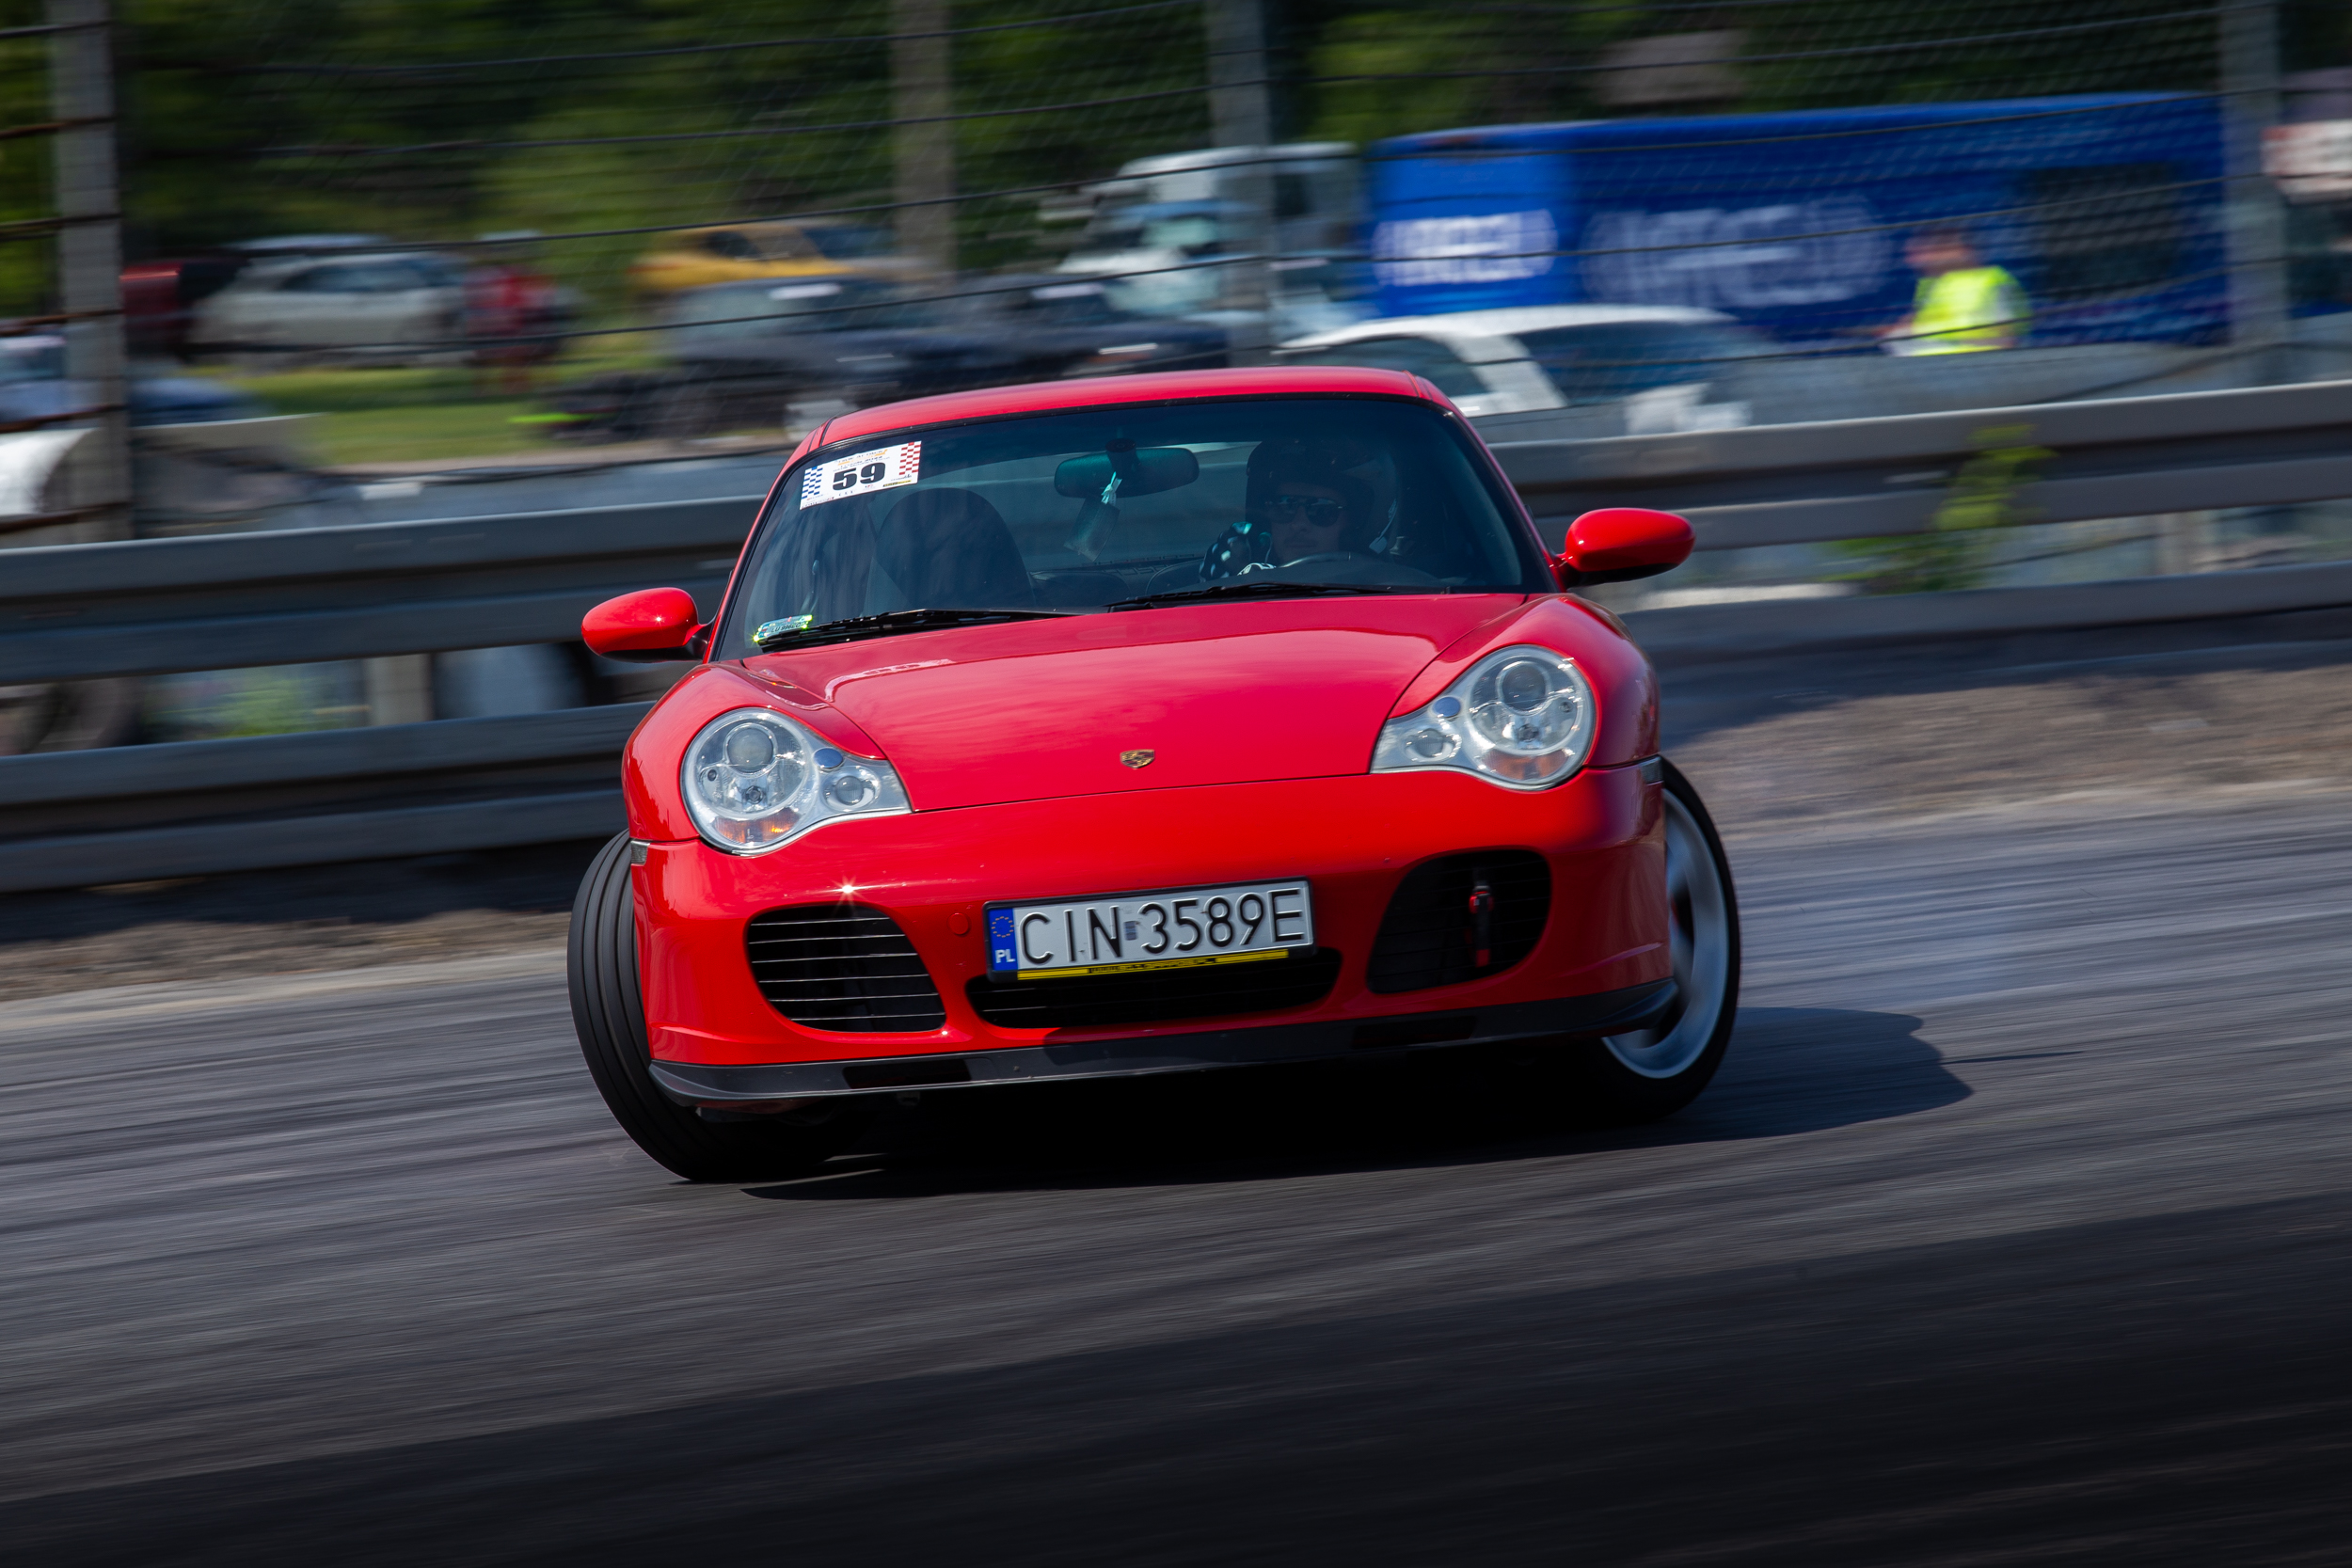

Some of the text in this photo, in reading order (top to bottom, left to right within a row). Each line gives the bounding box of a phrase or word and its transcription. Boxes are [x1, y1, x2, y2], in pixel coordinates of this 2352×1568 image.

[833, 462, 886, 491] 59
[1019, 888, 1305, 966] CIN 3589E
[994, 948, 1016, 964] PL
